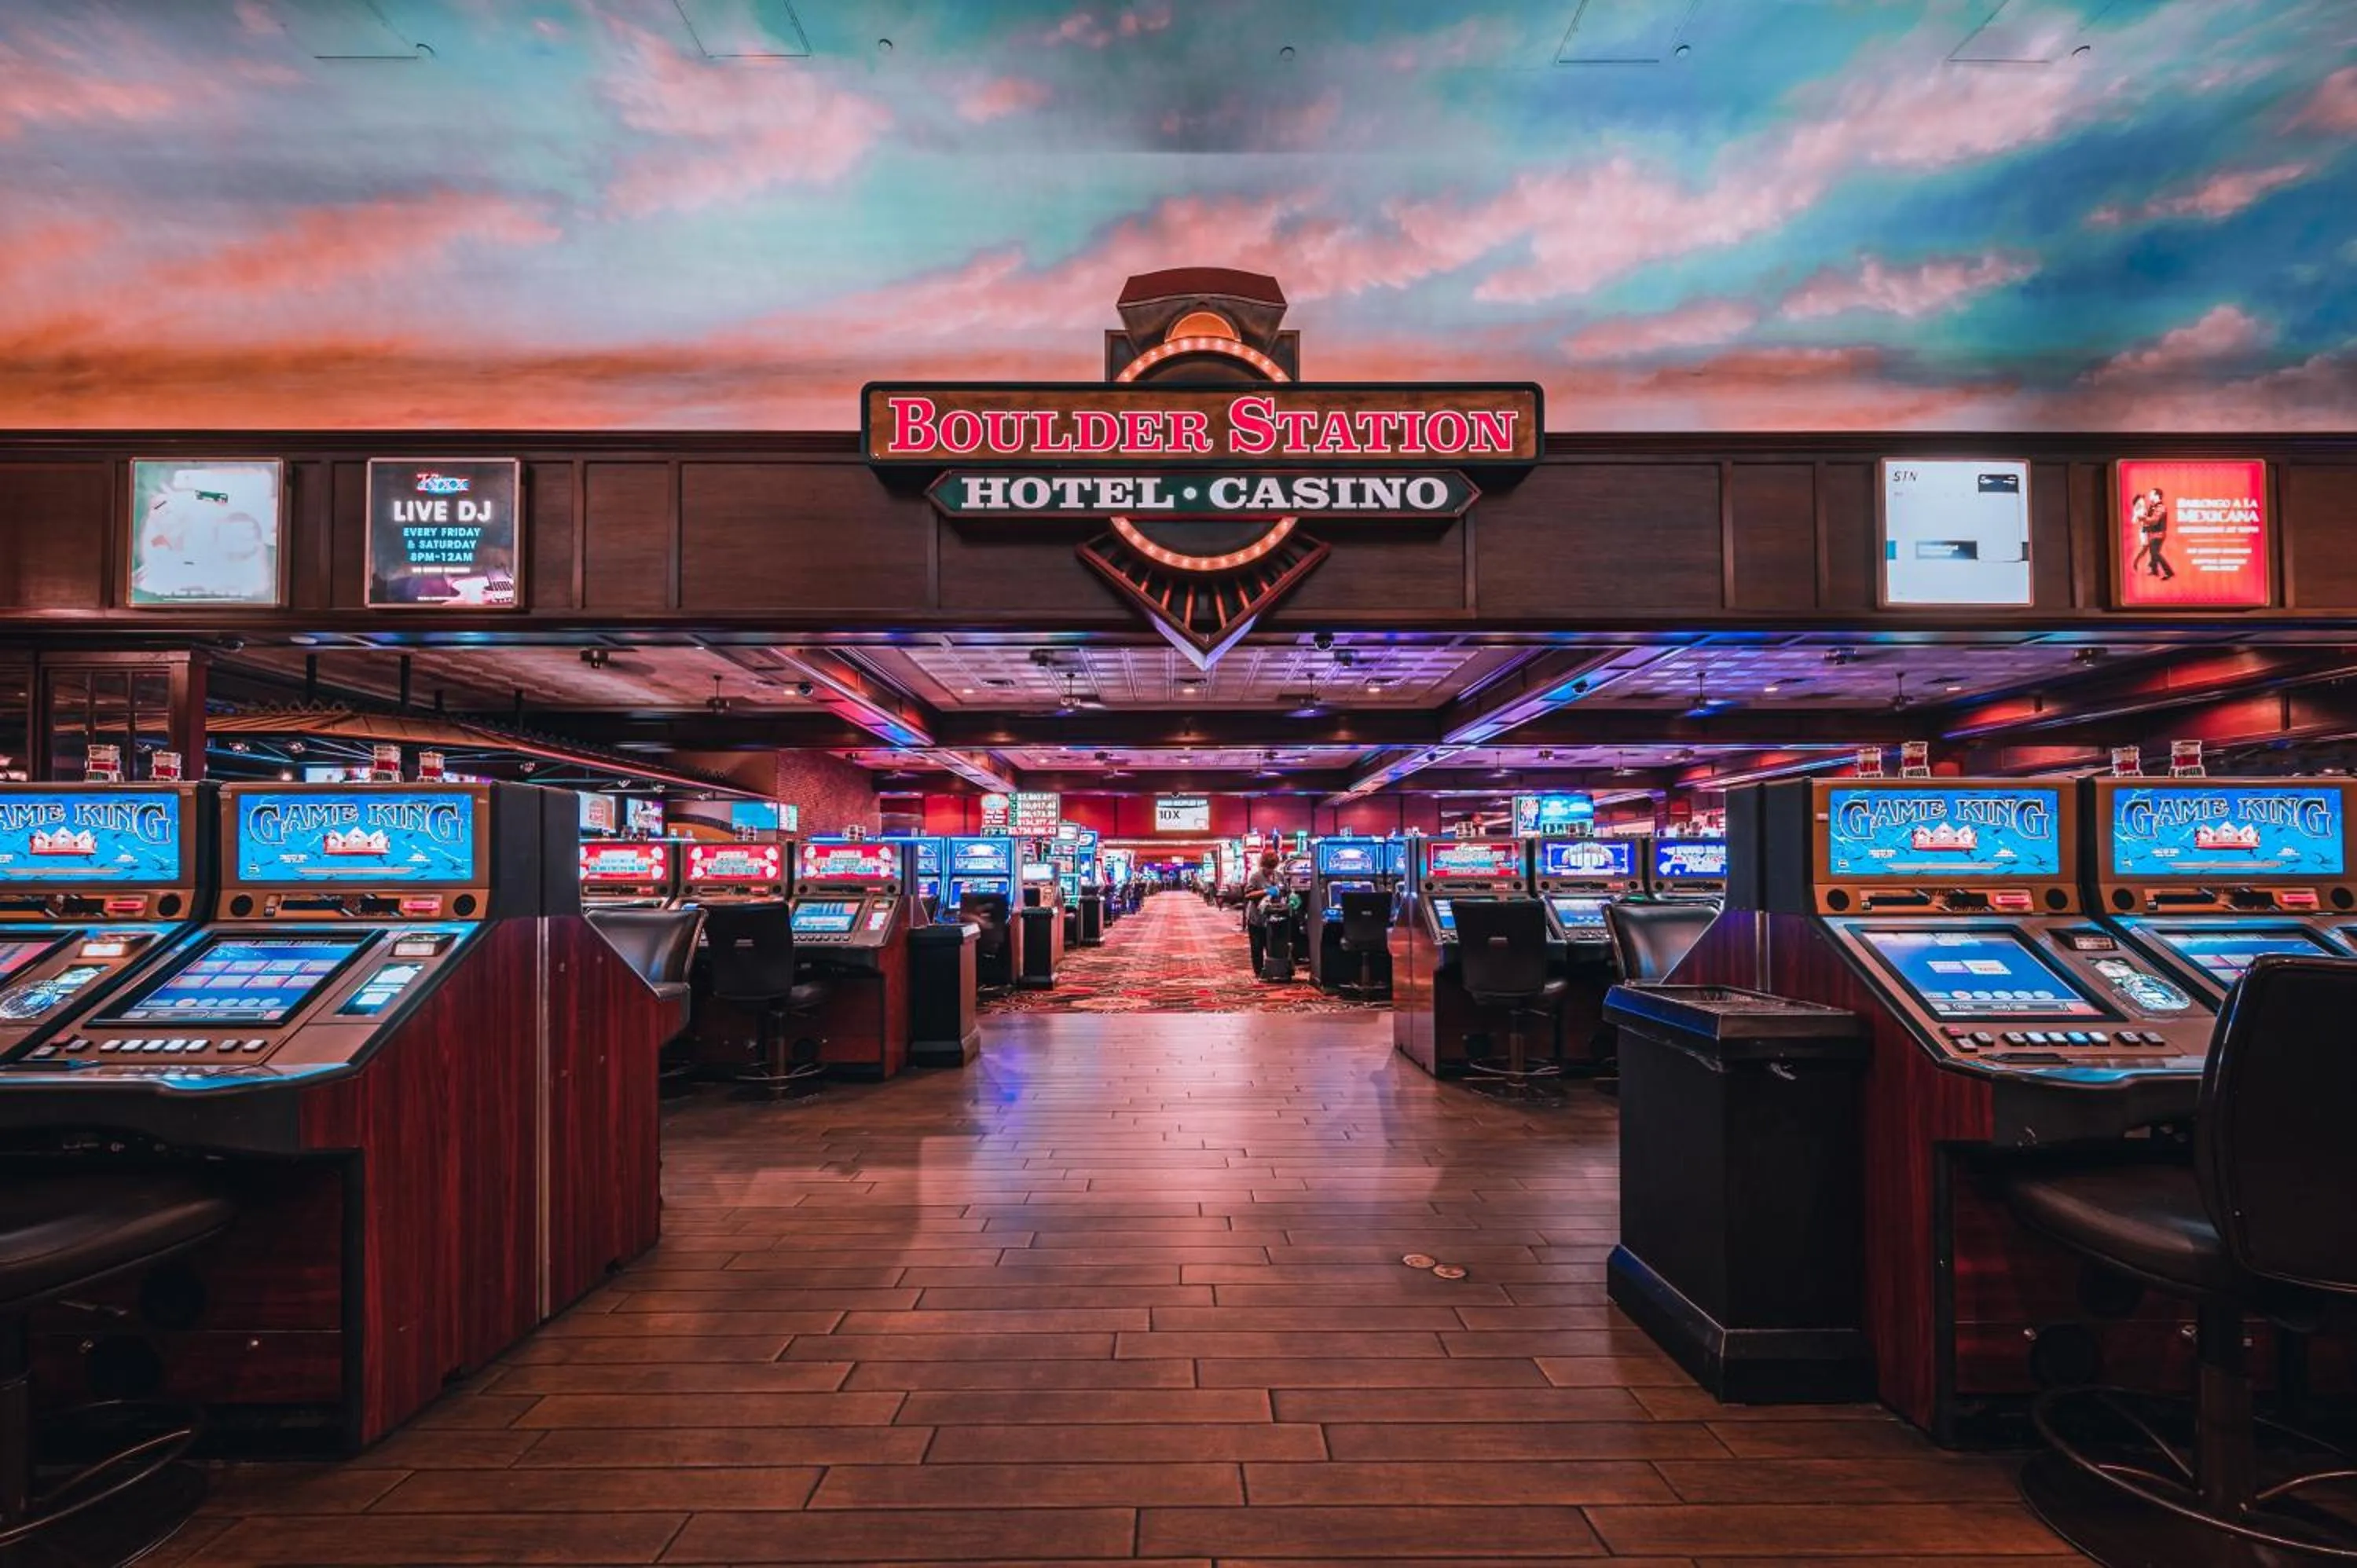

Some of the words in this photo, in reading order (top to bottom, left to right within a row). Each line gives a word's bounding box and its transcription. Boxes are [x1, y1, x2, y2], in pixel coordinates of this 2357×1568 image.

[888, 397, 1213, 453] BOULDER
[1230, 397, 1518, 453] STATION
[961, 477, 1175, 509] HOTEL
[1210, 477, 1448, 509] CASINO
[394, 500, 448, 522] LIVE
[457, 500, 492, 522] DJ
[2176, 510, 2260, 522] MEXICANA
[403, 527, 438, 537] EVERY
[441, 527, 482, 537] FRIDAY
[407, 540, 416, 549] &
[419, 540, 477, 549] SATURDAY
[410, 552, 473, 562] 8PM-12AM
[0, 803, 66, 830] AME
[74, 803, 171, 844] KING
[249, 804, 359, 844] GAME
[367, 803, 464, 844] KING
[1838, 799, 1948, 839] GAME
[1955, 799, 2049, 839] KING
[2122, 798, 2230, 839] GAME
[2237, 797, 2332, 838] KING
